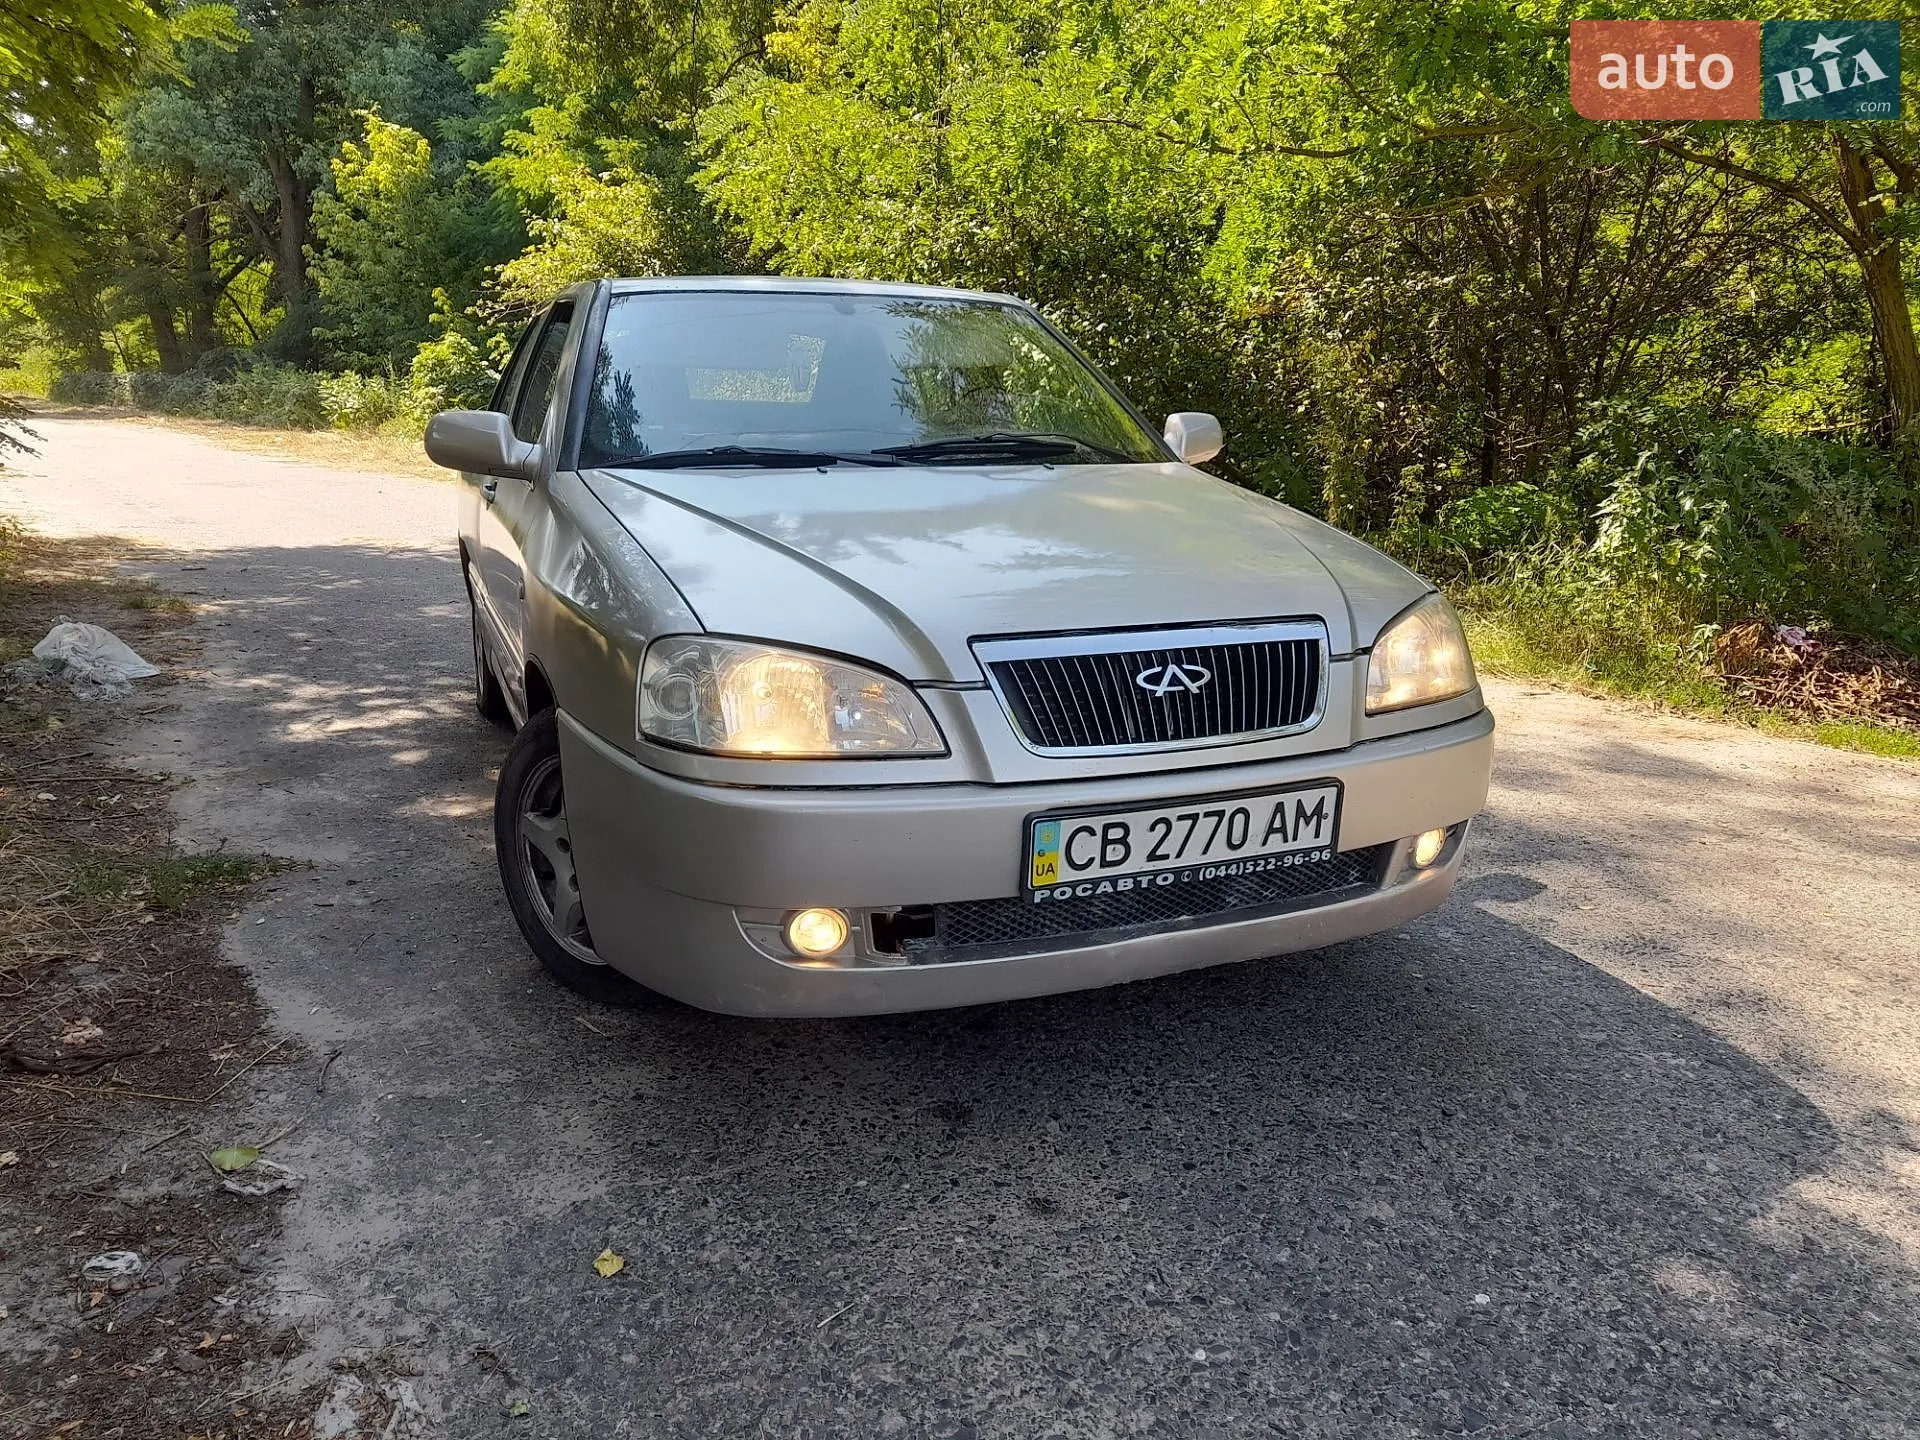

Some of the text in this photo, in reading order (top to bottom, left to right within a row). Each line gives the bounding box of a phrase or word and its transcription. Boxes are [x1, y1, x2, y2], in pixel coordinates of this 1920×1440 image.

[1064, 795, 1326, 872] CB 2770 AM
[1033, 849, 1331, 904] РОСАВТО (044)522-96-96
[1035, 861, 1055, 878] UA
